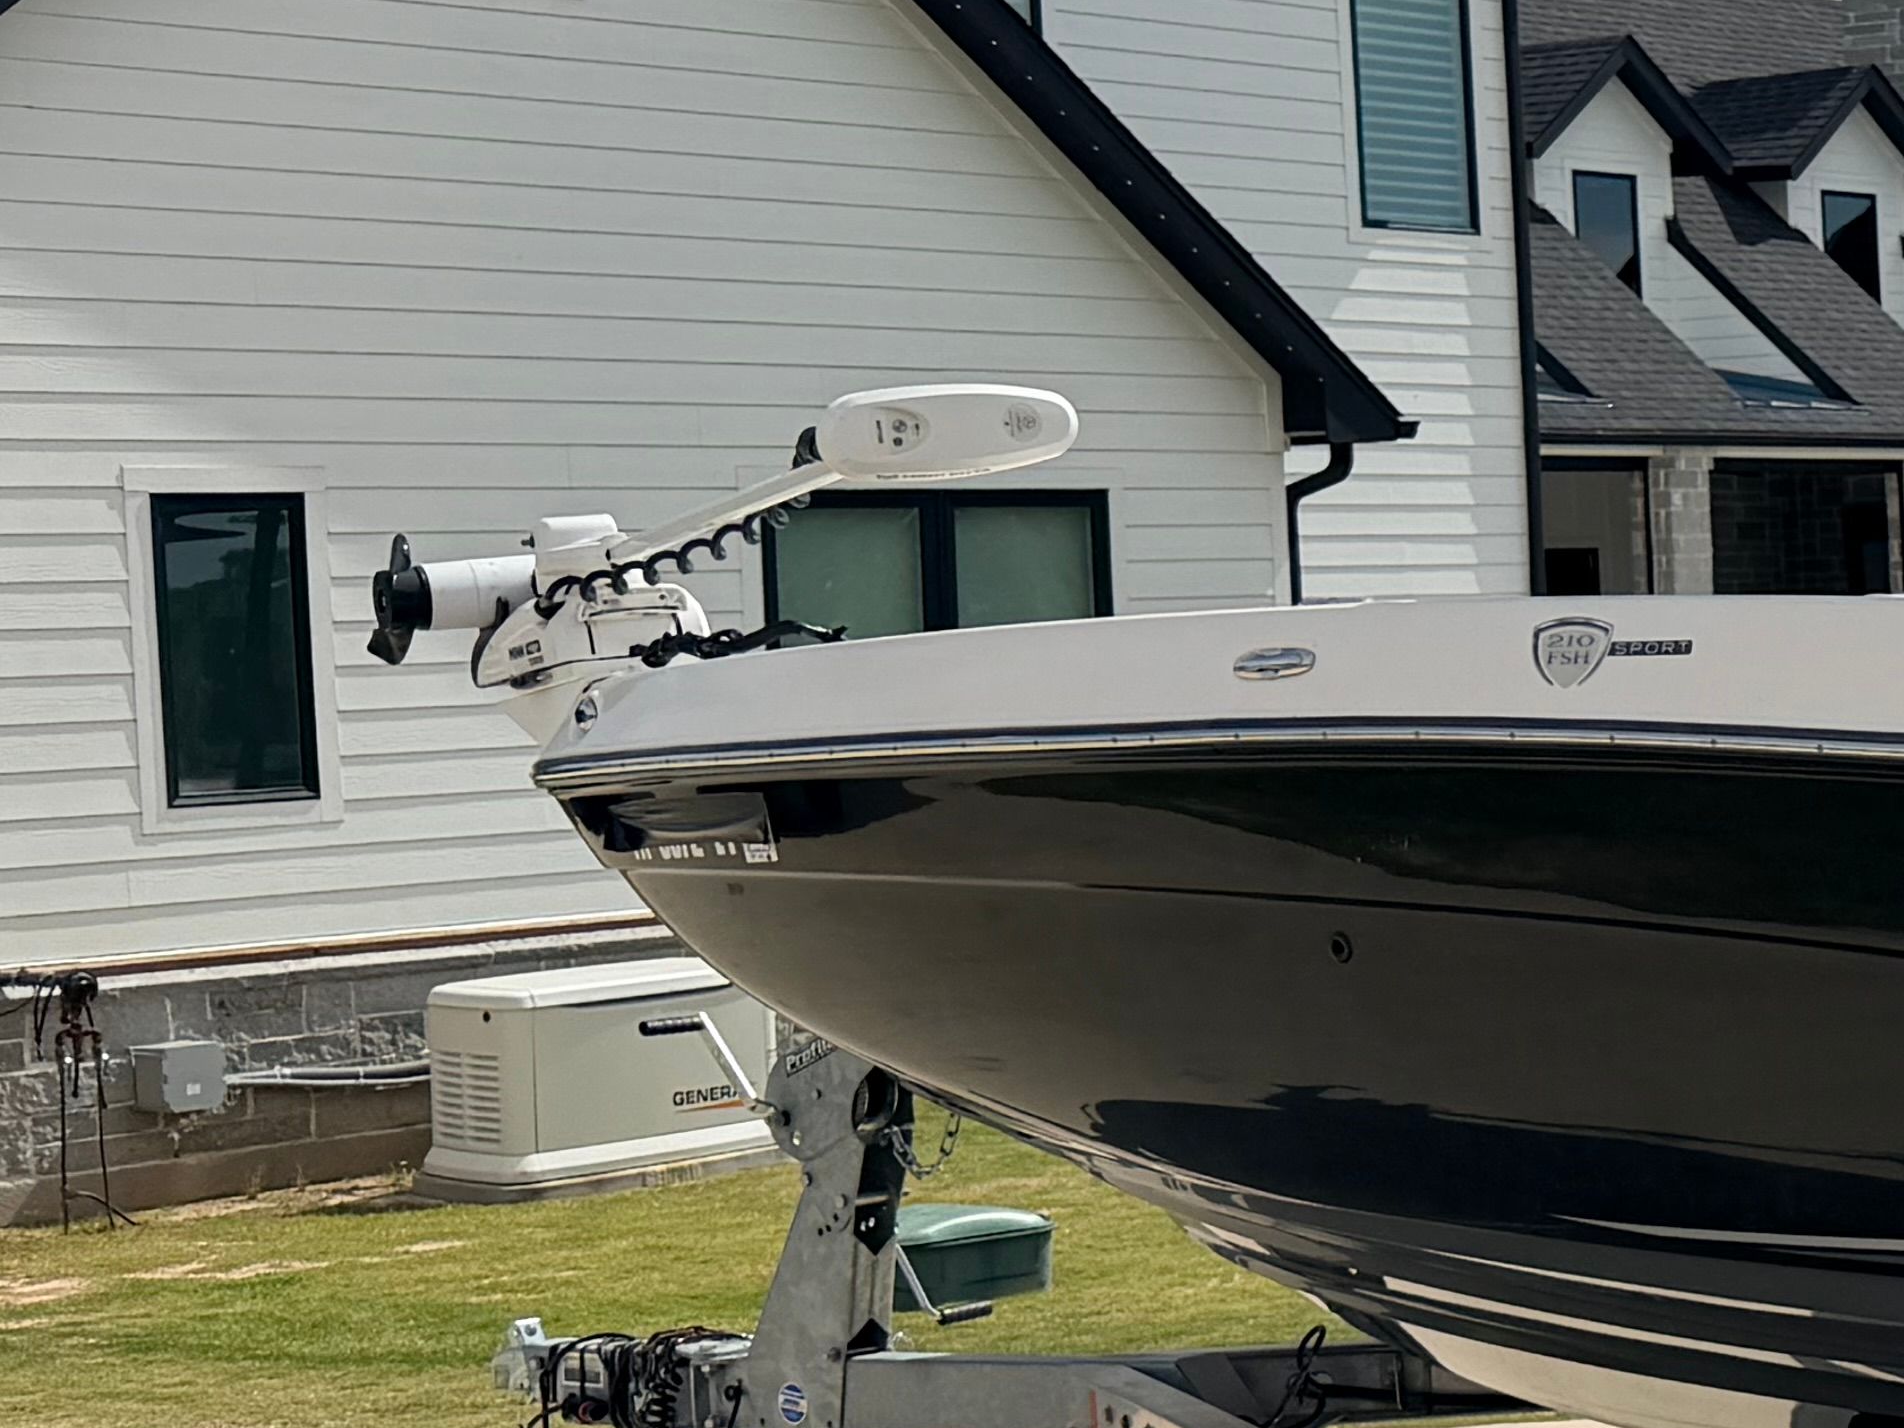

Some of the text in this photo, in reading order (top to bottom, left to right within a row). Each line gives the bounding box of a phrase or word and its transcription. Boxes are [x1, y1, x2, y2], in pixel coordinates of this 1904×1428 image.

[1548, 634, 1594, 648] 210
[1614, 641, 1689, 655] SPORT
[1547, 651, 1590, 665] FSH
